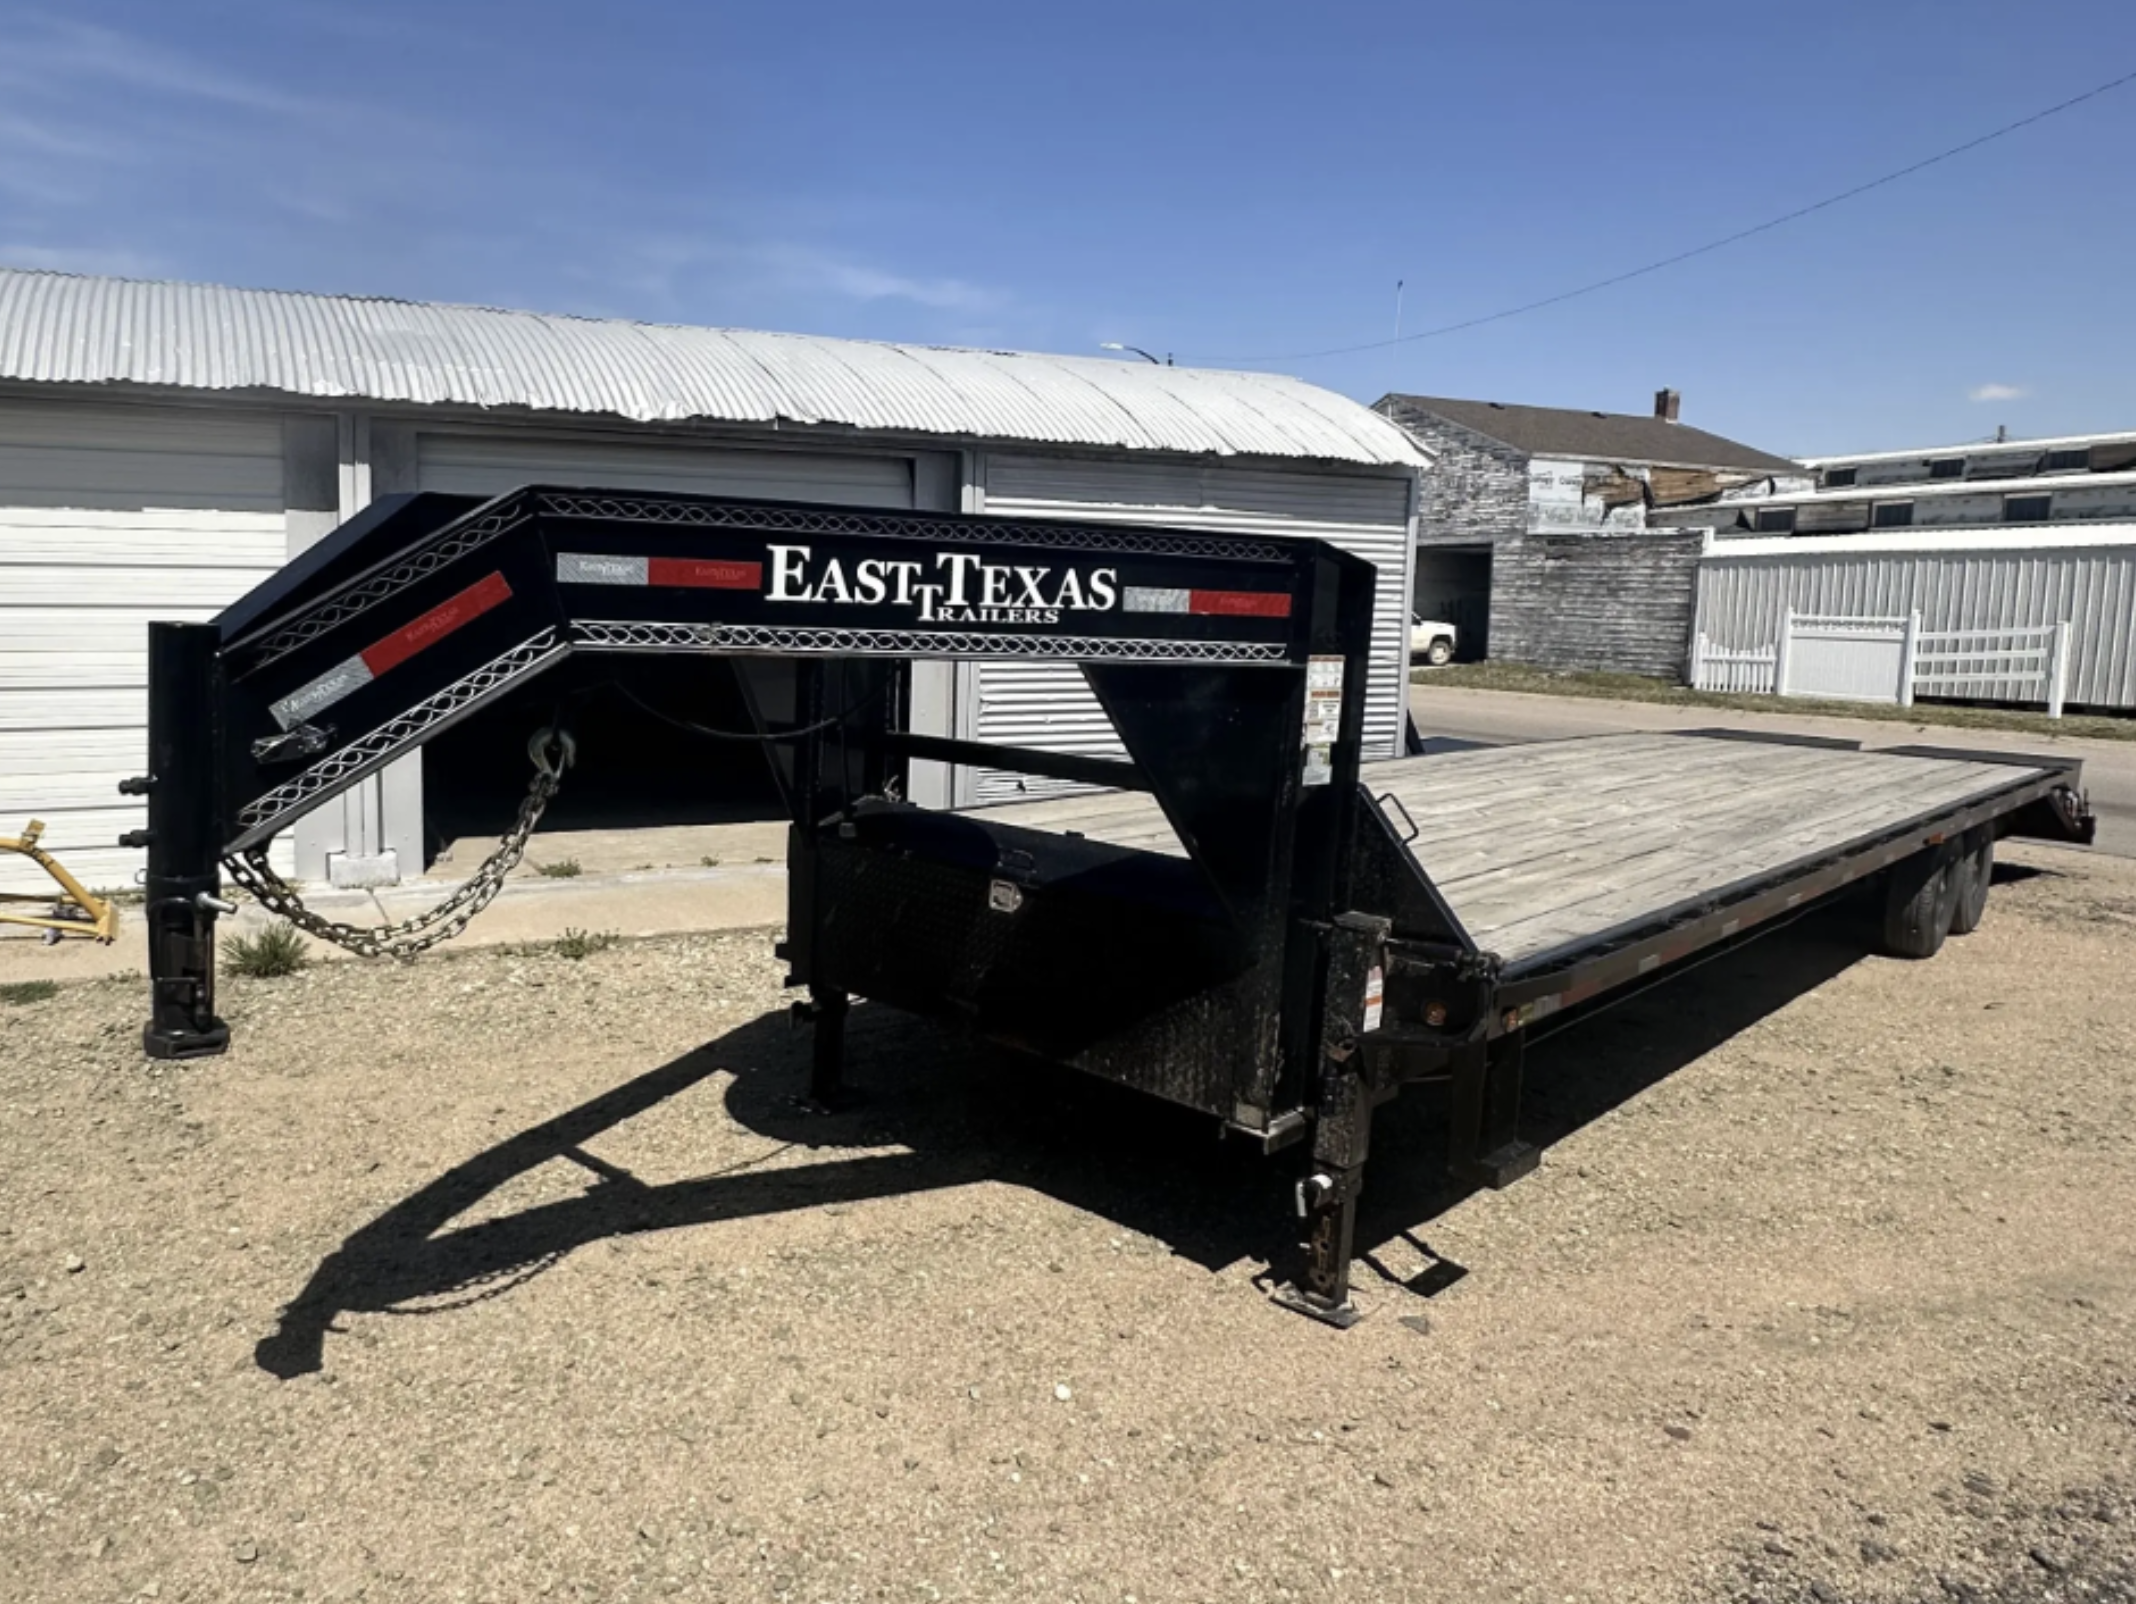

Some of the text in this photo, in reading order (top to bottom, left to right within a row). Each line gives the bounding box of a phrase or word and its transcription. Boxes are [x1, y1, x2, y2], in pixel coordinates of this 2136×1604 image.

[765, 544, 1116, 611] EAST TEXAS
[911, 584, 1059, 624] TRAILERS
